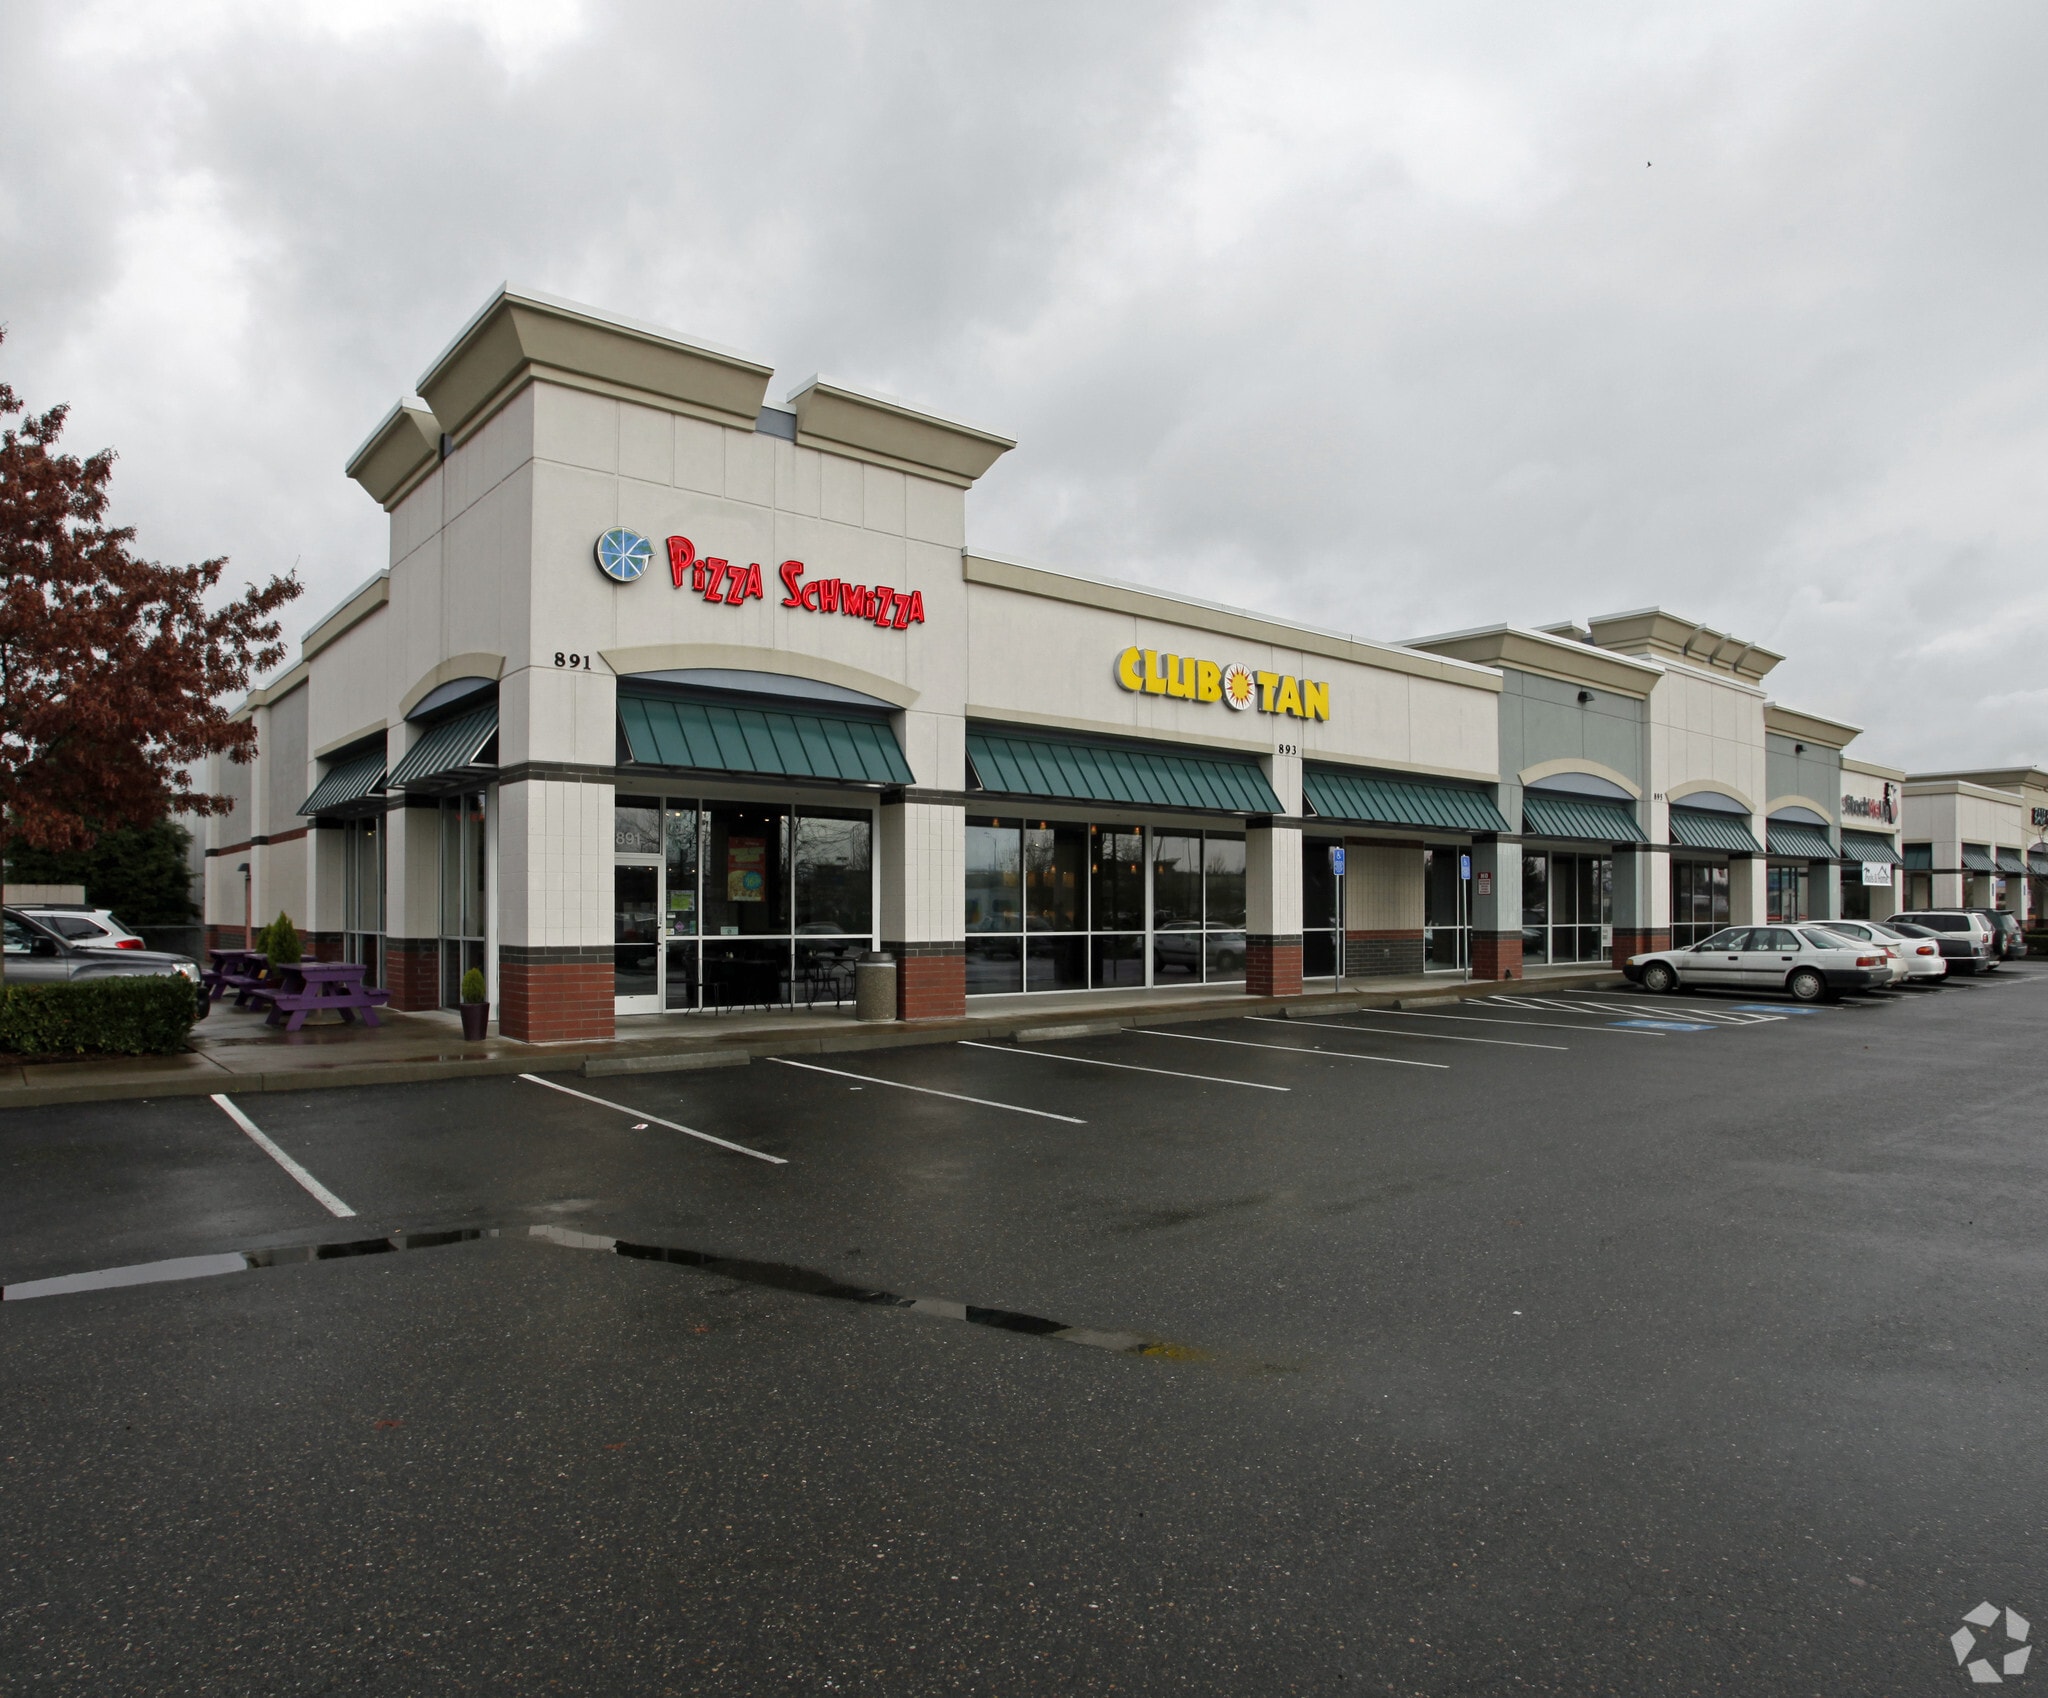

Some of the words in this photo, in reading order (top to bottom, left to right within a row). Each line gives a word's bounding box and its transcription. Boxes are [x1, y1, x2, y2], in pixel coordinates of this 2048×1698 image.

[554, 652, 591, 670] 891
[1113, 646, 1223, 704] CLUB
[1252, 669, 1330, 722] TAN
[1278, 743, 1297, 755] 893
[616, 831, 641, 846] 891
